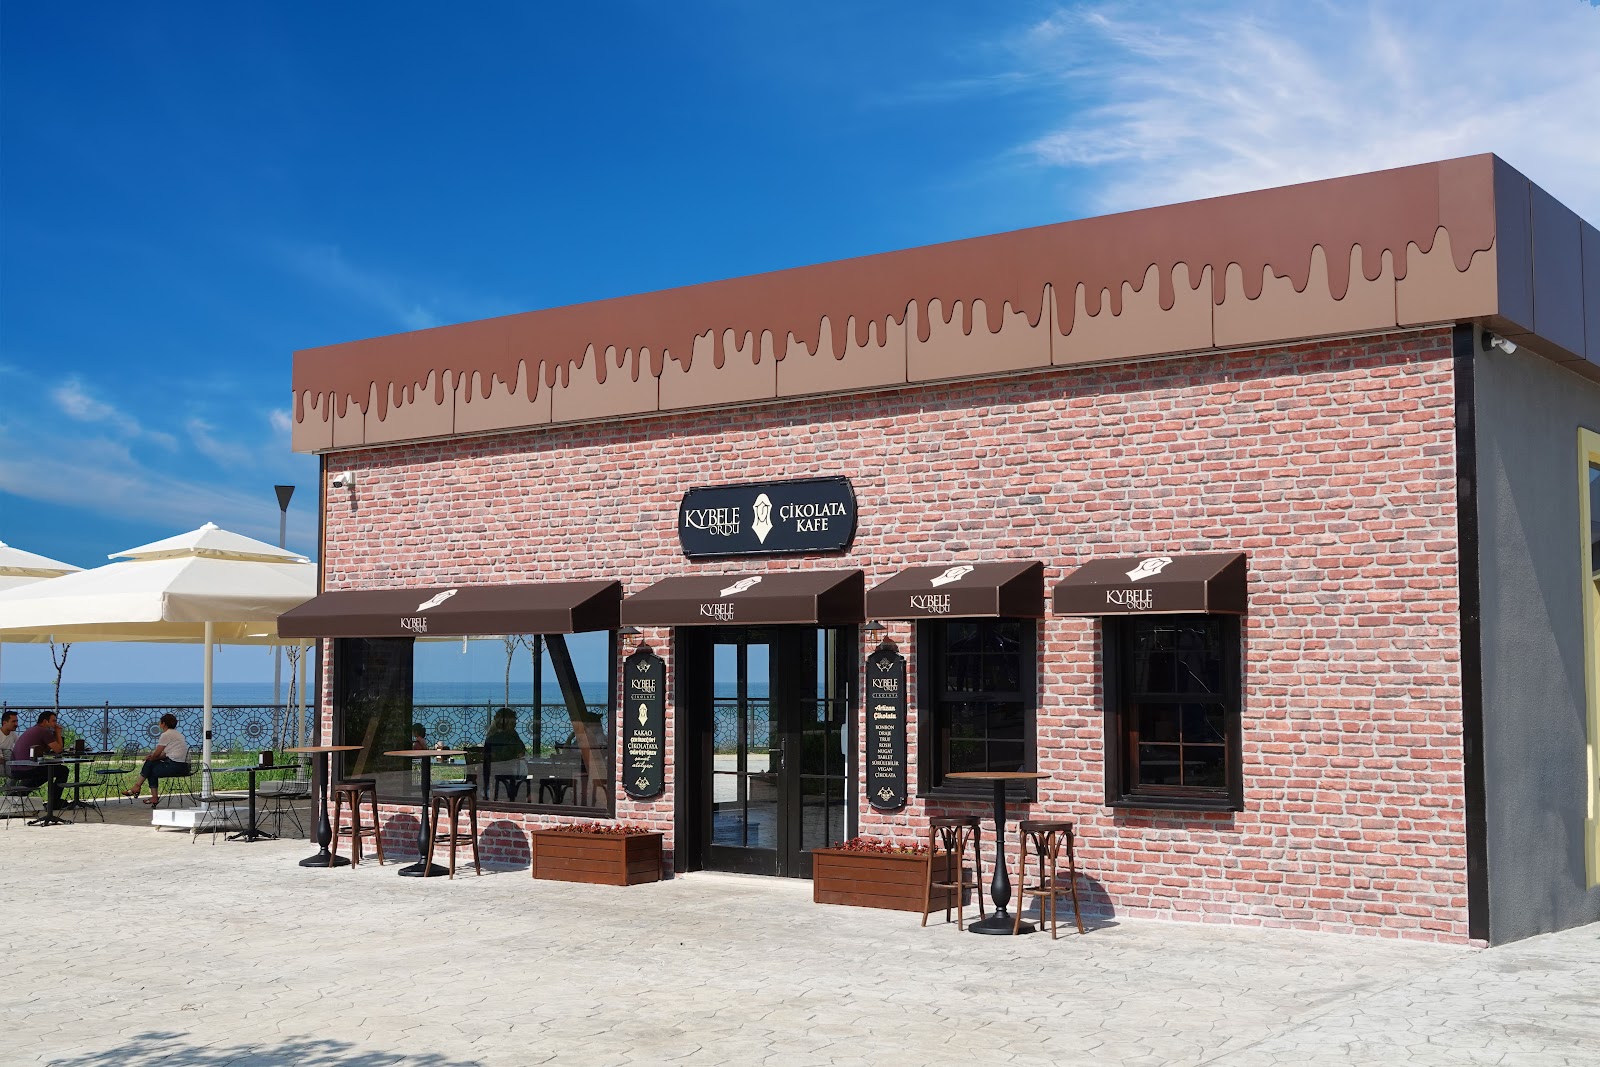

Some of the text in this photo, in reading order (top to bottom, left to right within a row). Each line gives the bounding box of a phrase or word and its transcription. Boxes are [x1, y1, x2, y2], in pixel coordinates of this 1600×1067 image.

[685, 507, 740, 529] KYBELE
[779, 502, 847, 522] ÇİKOLATA
[709, 524, 740, 536] ORDU
[796, 518, 829, 532] KAFE
[910, 594, 950, 608] KYBELE
[1106, 589, 1152, 604] KYBELE
[700, 603, 734, 617] KYBELE
[928, 605, 950, 614] ORDU
[1127, 600, 1152, 610] ORDU
[400, 617, 427, 629] KYBELE
[631, 679, 656, 689] KYBELE
[872, 678, 898, 688] KYBELE
